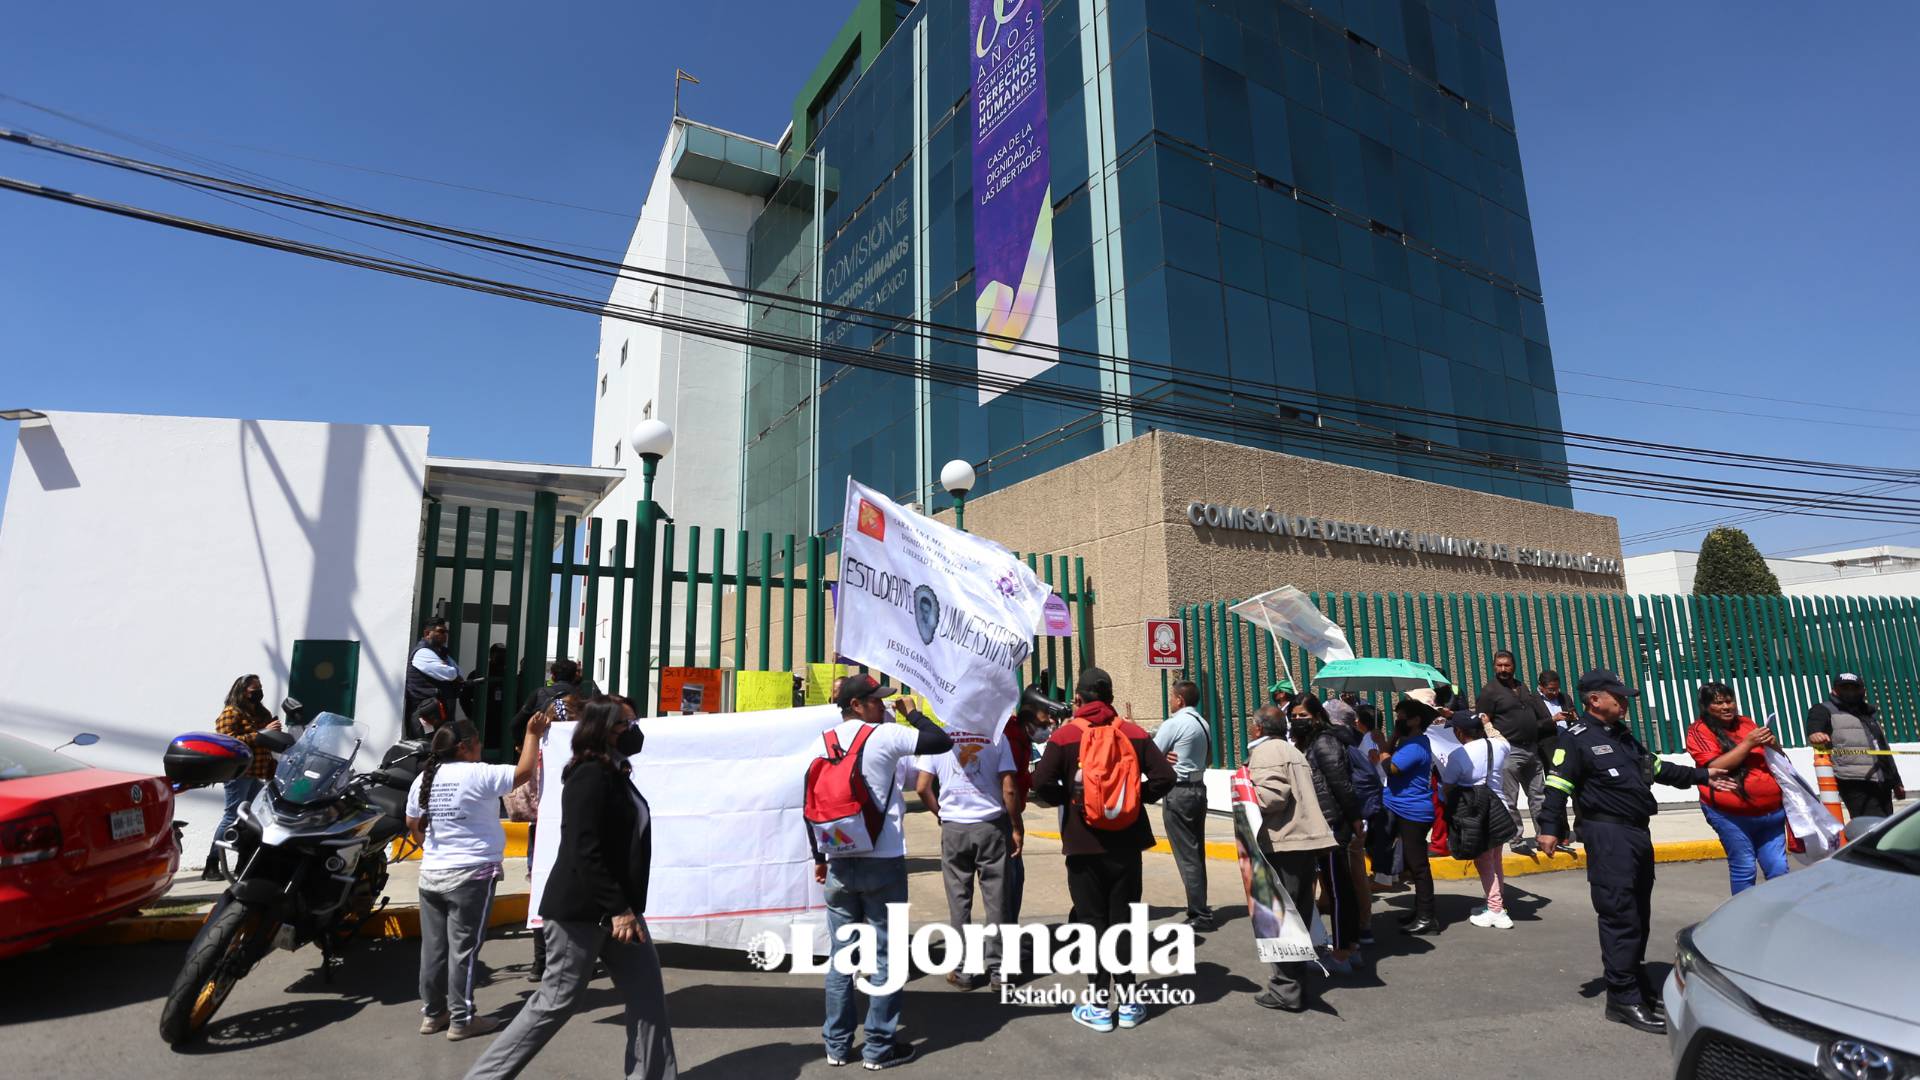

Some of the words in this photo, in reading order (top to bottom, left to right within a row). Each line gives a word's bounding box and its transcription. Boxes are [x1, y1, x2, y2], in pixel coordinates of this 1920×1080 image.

[1023, 34, 1035, 52] DE
[979, 47, 1036, 113] DERECHOS
[979, 62, 1037, 128] HUMANOS
[987, 145, 1008, 169] CASA
[1008, 132, 1020, 150] DE
[1020, 122, 1032, 139] LA
[988, 107, 1007, 128] ESTADO
[981, 186, 995, 206] LAS
[996, 145, 1042, 193] LIBERTADES
[986, 144, 1026, 186] DIGNIDAD
[1027, 135, 1034, 148] Y
[895, 197, 908, 226] DE
[864, 234, 909, 290] HUMANOS
[1187, 502, 1292, 536] COMISIÓN
[1295, 515, 1322, 540] DE
[1323, 519, 1414, 553] DERECHOS
[1416, 530, 1489, 560] HUMANOS
[846, 556, 914, 616] ESTUDIANTE
[939, 604, 1029, 672] UNIVERSITARIO
[1271, 943, 1310, 960] Aguilar
